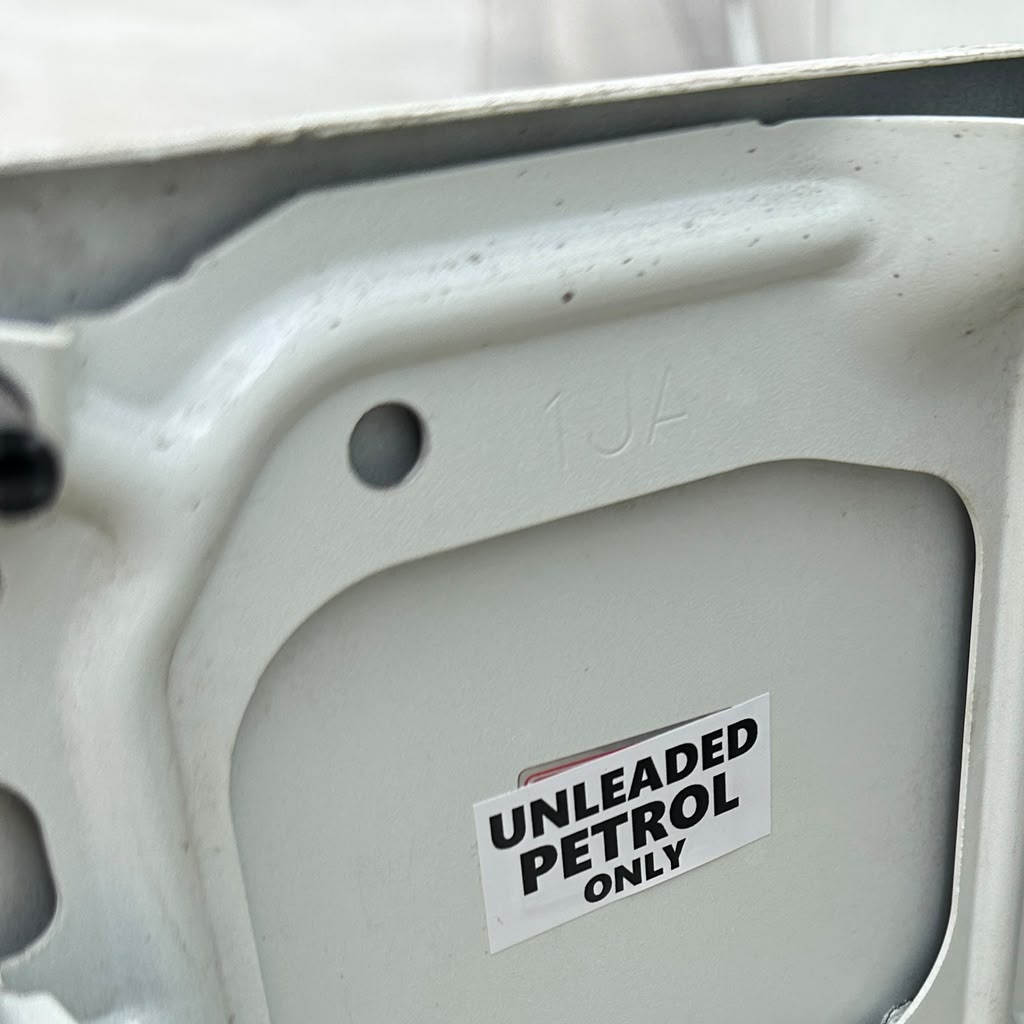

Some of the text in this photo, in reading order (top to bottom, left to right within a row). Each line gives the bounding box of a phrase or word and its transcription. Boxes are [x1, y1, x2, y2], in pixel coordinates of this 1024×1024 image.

[489, 718, 759, 850] UNLEADED
[519, 771, 740, 896] PETROL
[583, 838, 686, 903] ONLY
